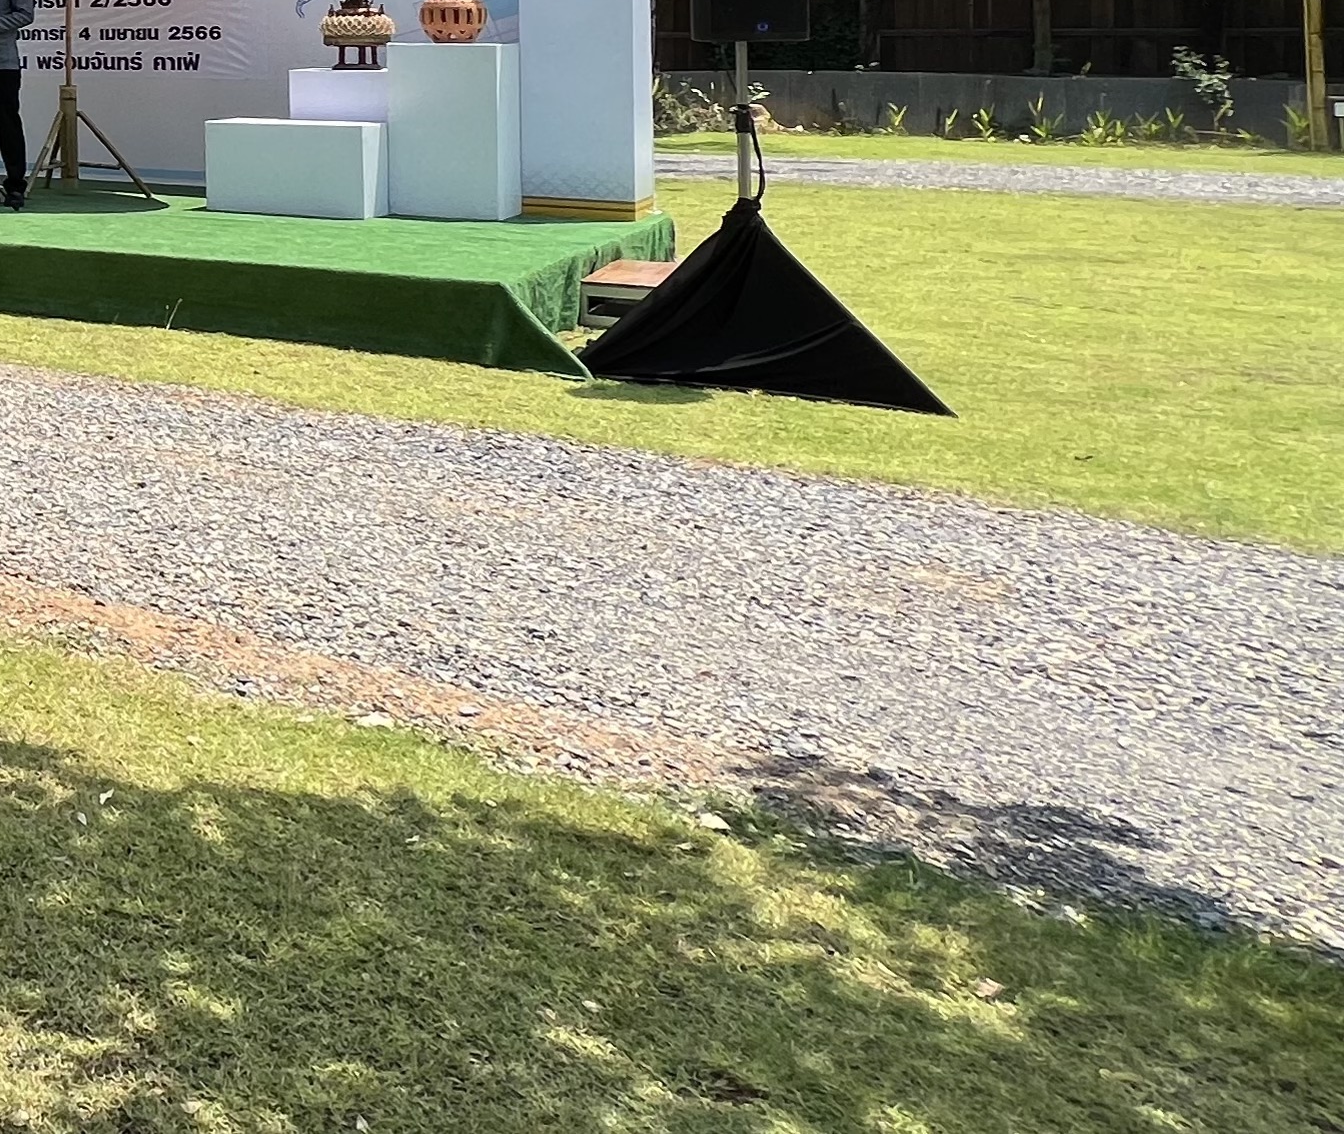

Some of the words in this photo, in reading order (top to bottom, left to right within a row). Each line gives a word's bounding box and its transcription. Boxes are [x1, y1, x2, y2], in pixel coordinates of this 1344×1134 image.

[78, 26, 91, 41] 4
[100, 27, 159, 41] เมษายน
[168, 25, 222, 41] 2566
